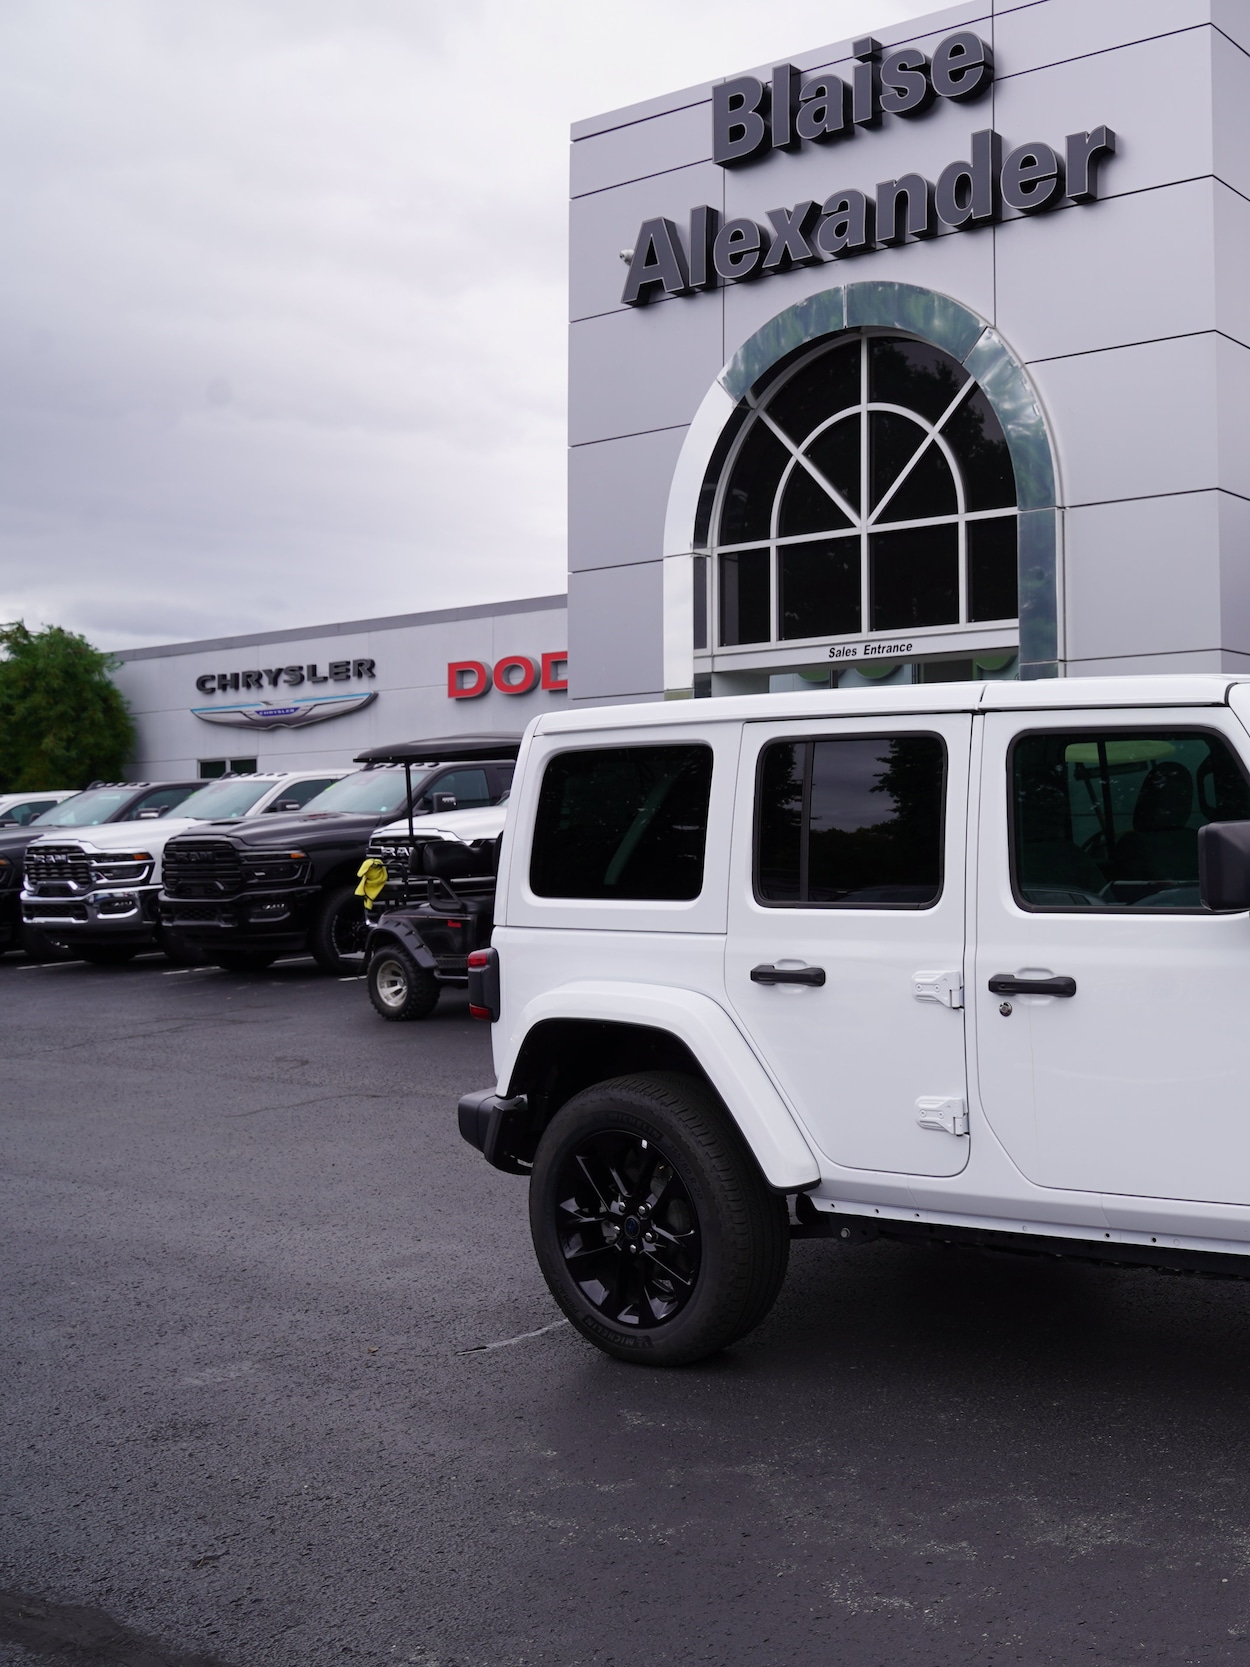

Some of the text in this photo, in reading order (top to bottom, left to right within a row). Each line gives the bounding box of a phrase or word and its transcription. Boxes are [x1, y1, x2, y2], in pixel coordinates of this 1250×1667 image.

[711, 31, 993, 168] Blaise
[621, 125, 1116, 307] Alexander
[828, 643, 913, 659] Sales Entrance
[196, 658, 377, 694] CHRYSLER
[258, 708, 296, 716] CHRYSLER
[33, 853, 70, 864] RAM
[381, 846, 414, 857] RA
[608, 1112, 661, 1139] MICHELIN
[586, 1318, 635, 1346] MICHELIN
